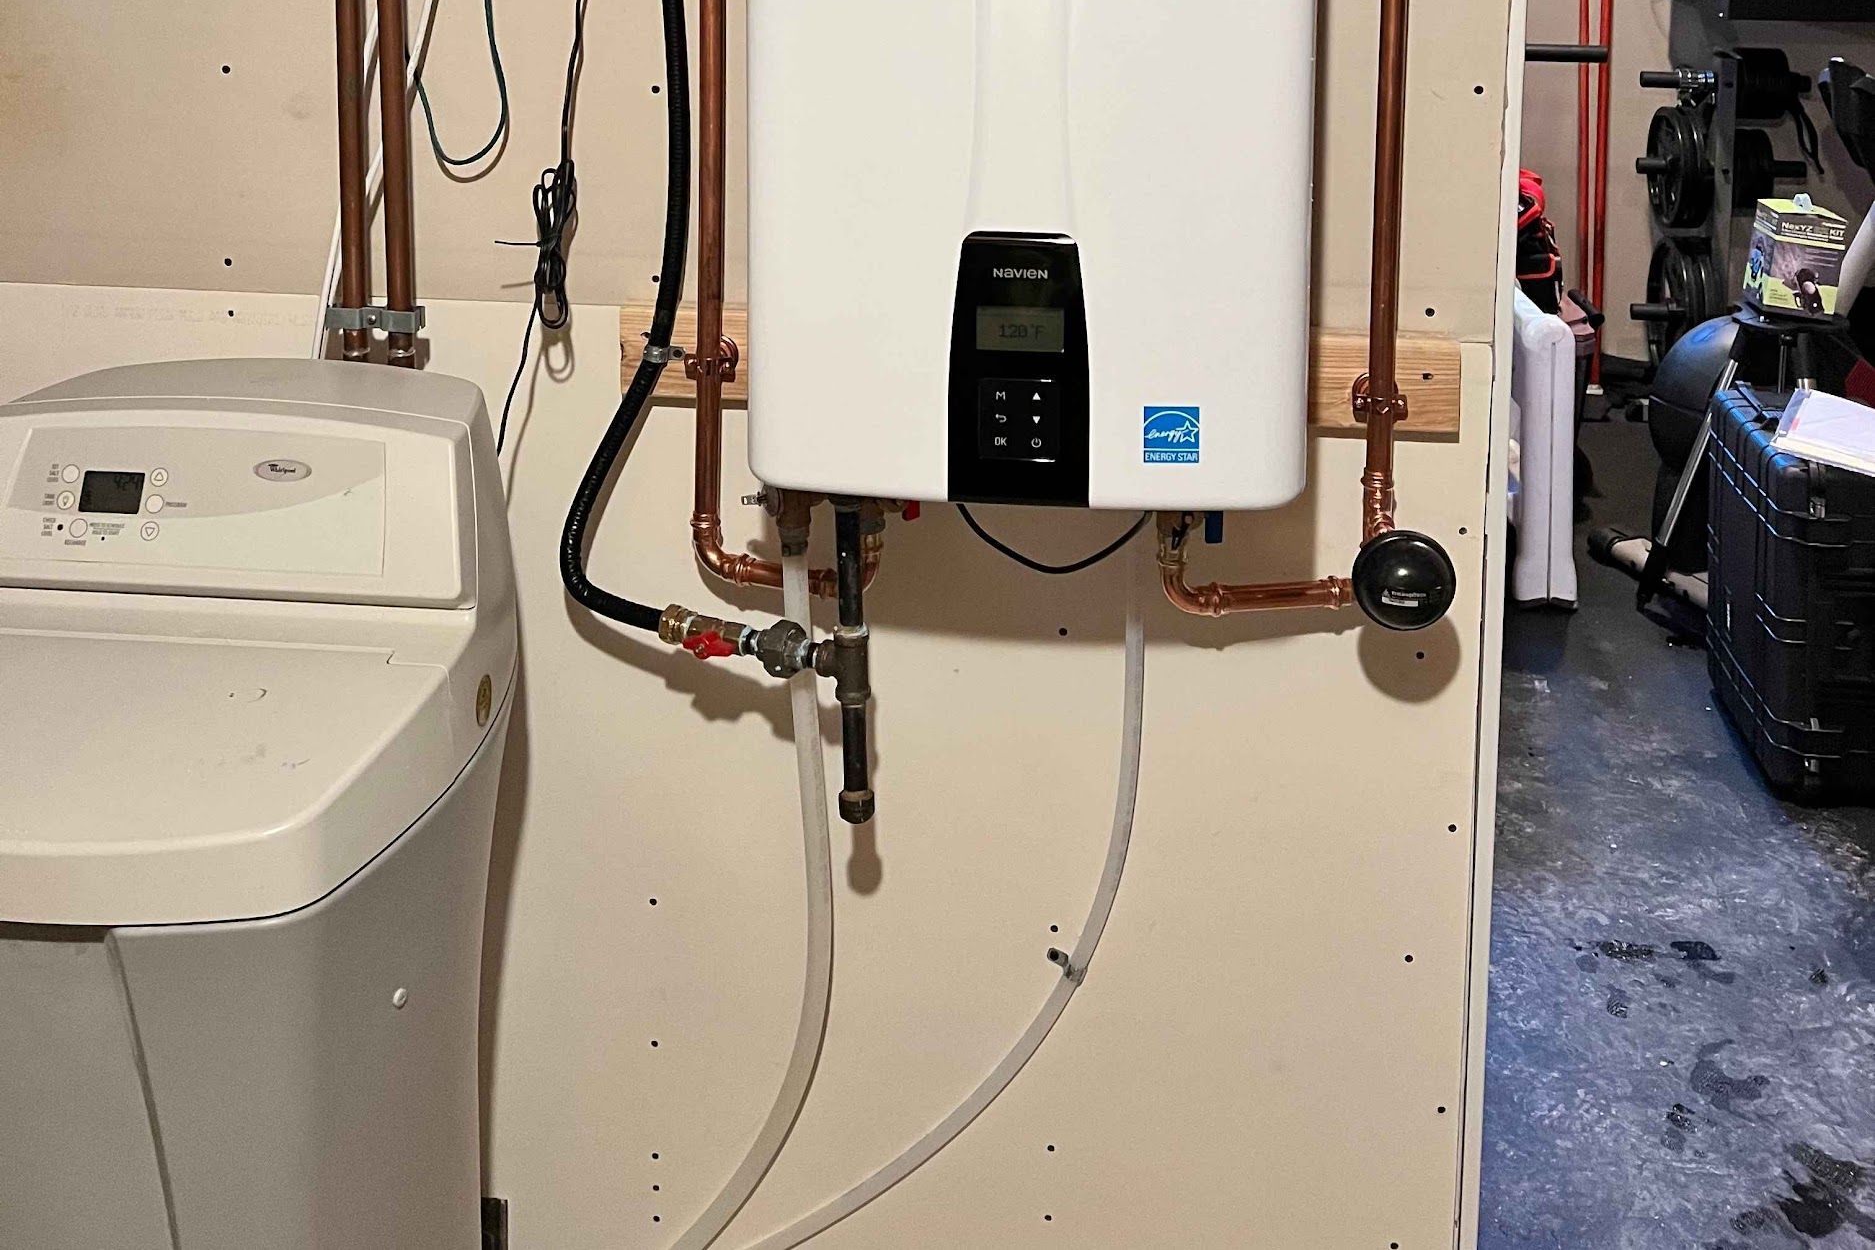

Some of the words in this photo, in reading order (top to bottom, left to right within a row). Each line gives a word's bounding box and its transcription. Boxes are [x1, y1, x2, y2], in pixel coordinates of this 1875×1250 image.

[1829, 228, 1845, 237] KIT
[995, 391, 1006, 400] M
[995, 437, 1007, 446] OK
[1145, 452, 1177, 461] ENERGY
[1177, 452, 1198, 461] STAR
